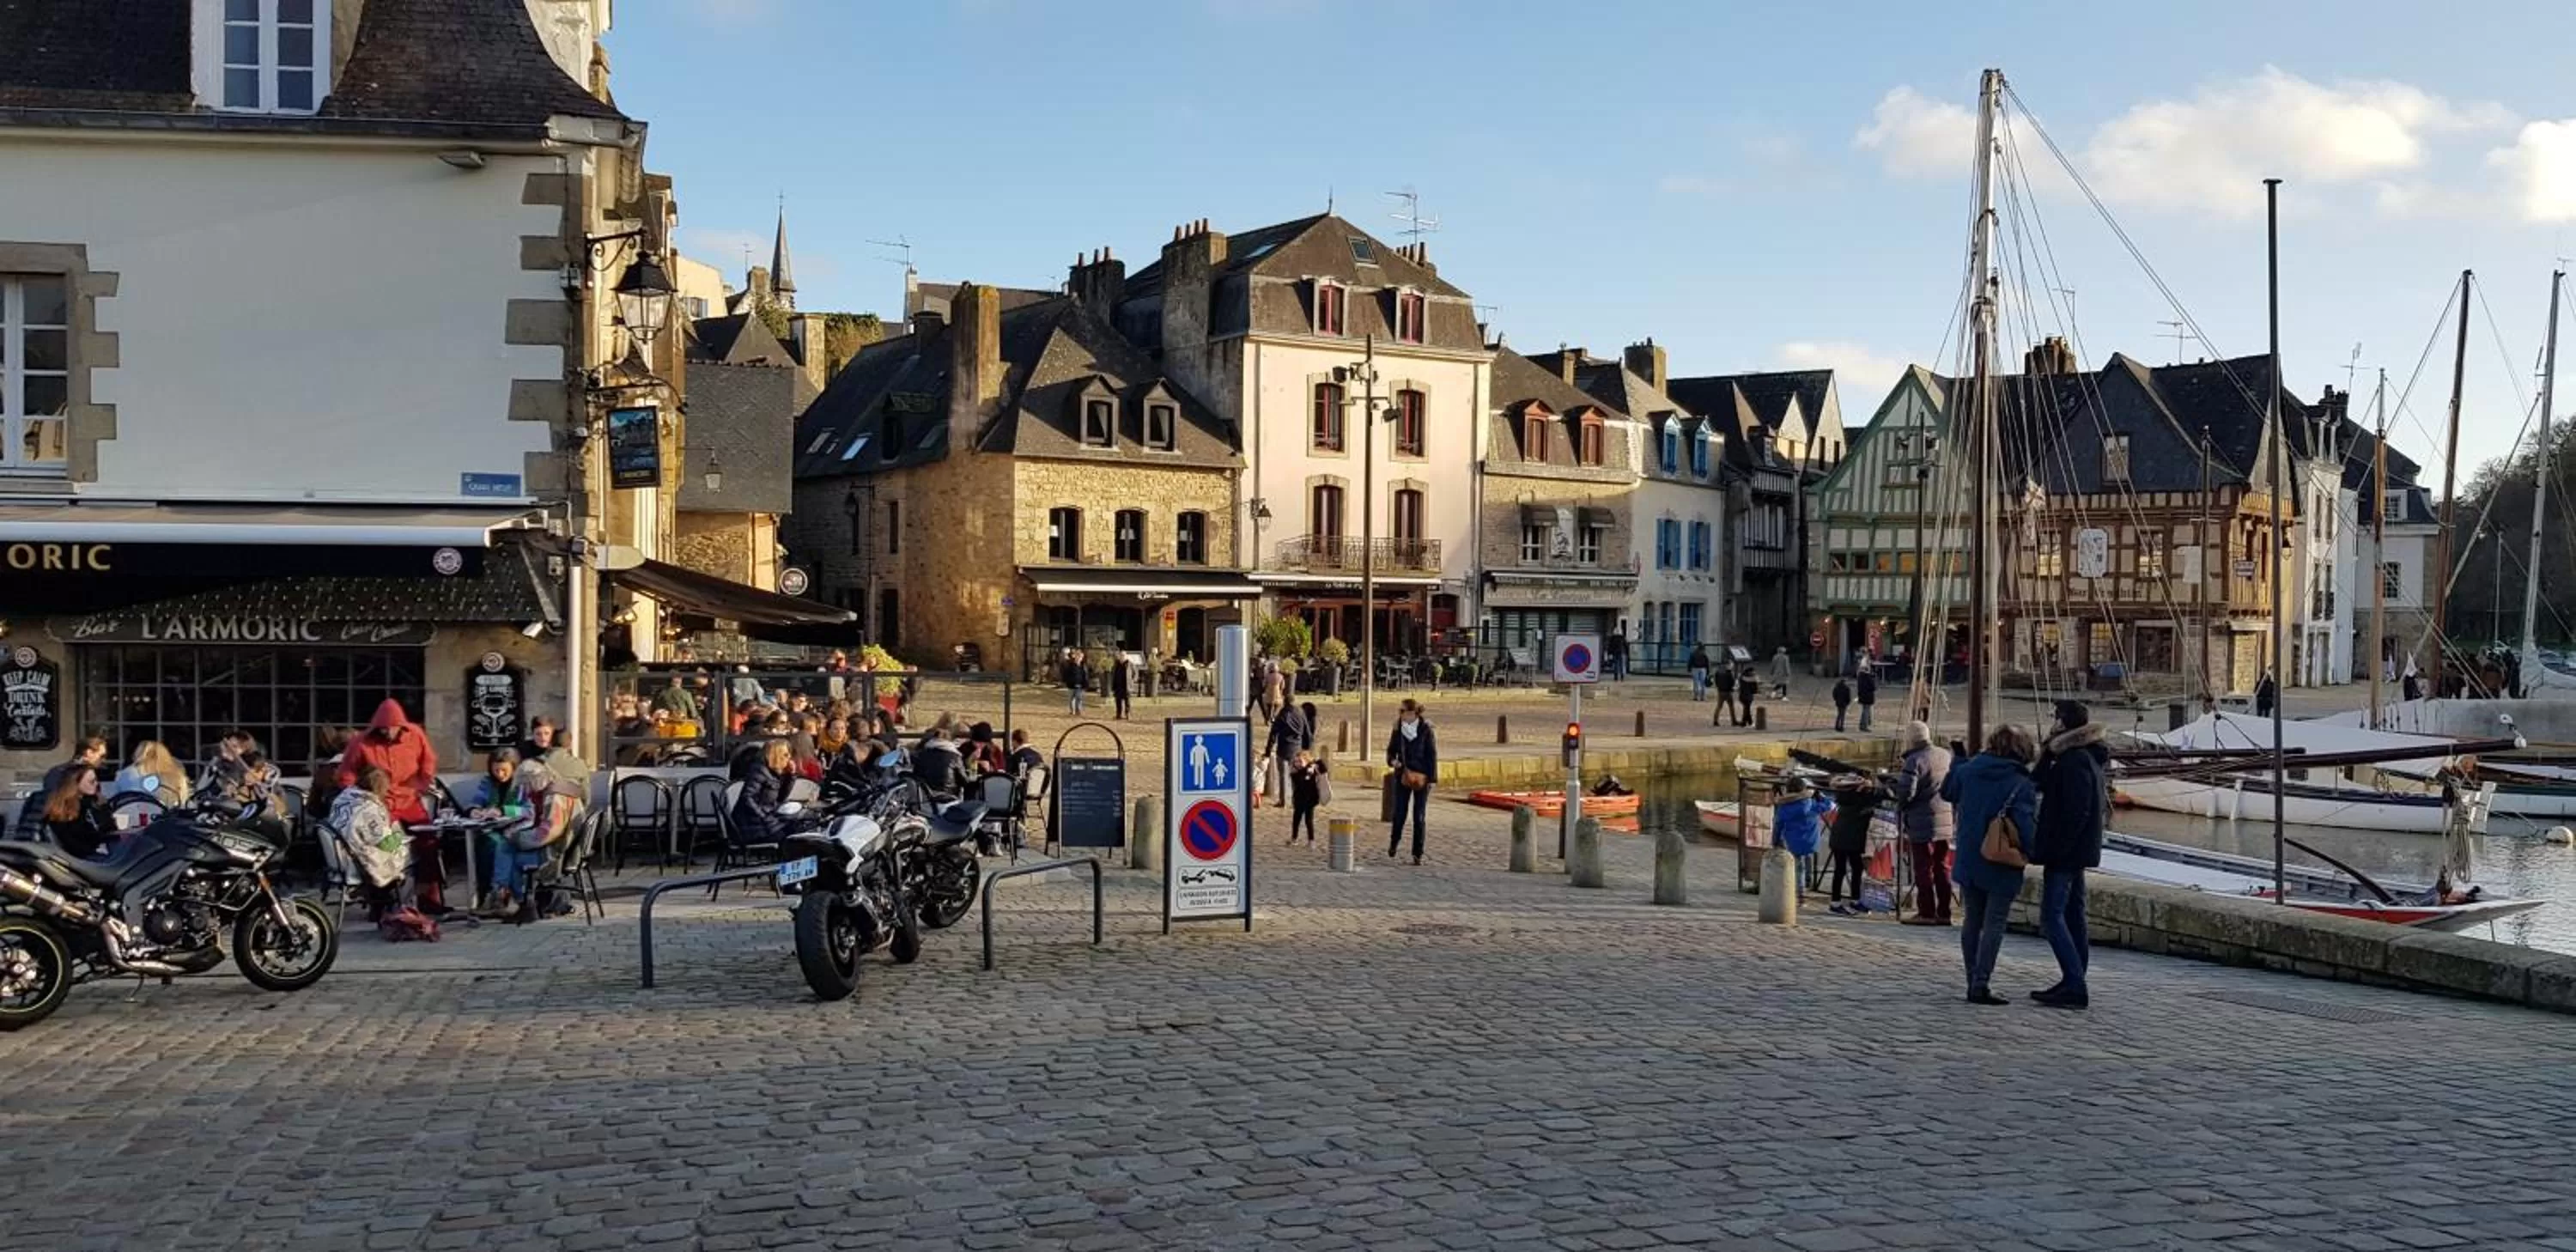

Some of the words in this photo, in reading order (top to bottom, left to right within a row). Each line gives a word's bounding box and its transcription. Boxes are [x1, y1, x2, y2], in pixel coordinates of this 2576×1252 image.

[6, 543, 112, 571] ORIC
[141, 613, 322, 641] L'ARMORIC
[8, 691, 46, 703] DRINK
